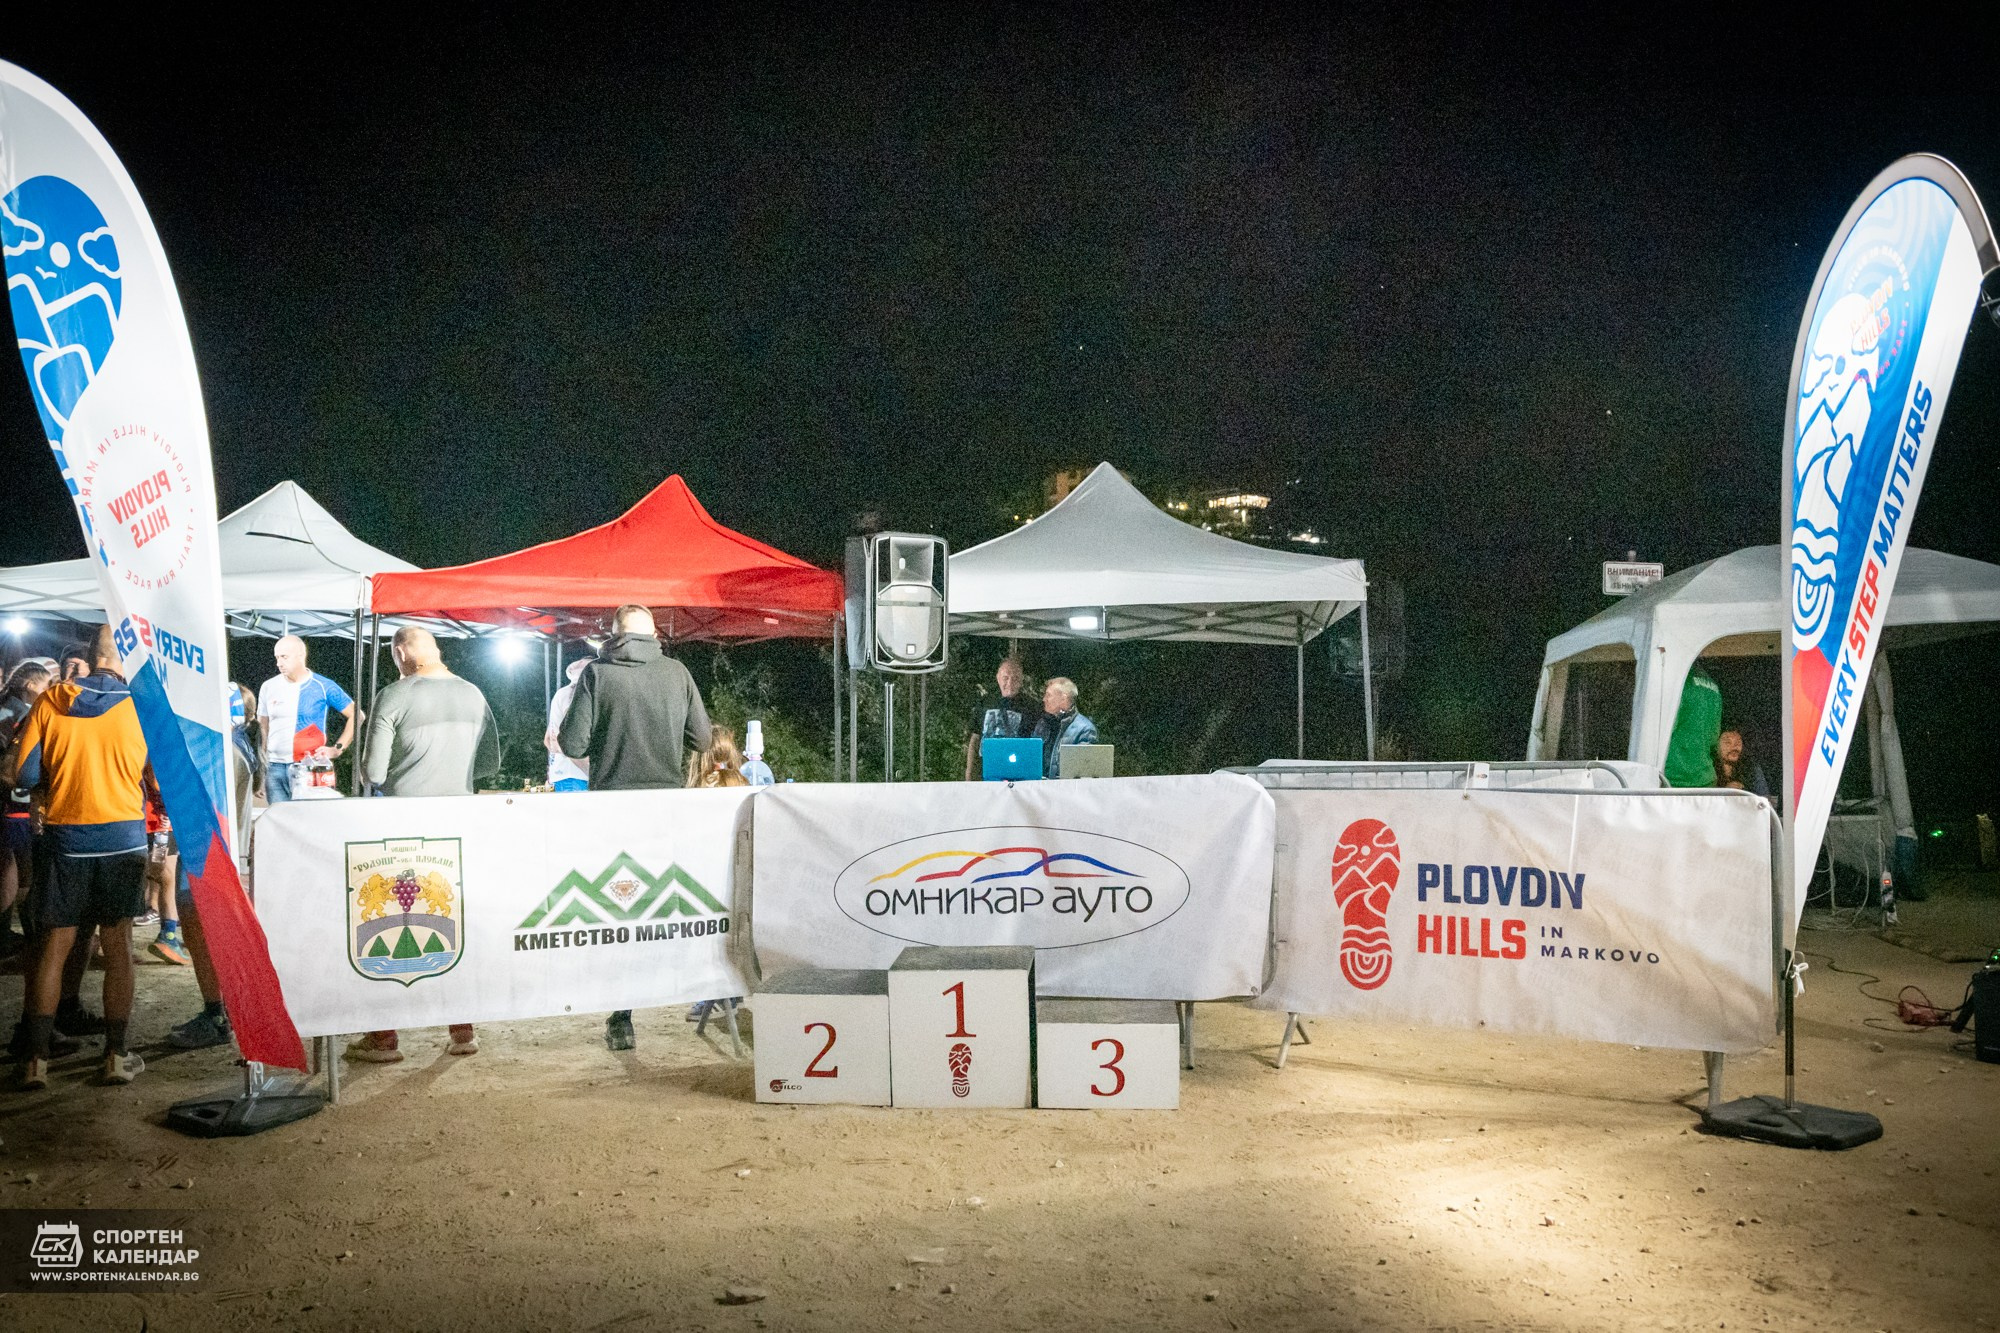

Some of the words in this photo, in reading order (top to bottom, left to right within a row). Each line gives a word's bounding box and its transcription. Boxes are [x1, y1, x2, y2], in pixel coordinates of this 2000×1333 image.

[1821, 650, 1860, 767] EVERY
[1849, 558, 1879, 660] STEP
[1872, 379, 1933, 568] MATTERS
[1418, 863, 1586, 909] PLOVDIV
[514, 926, 630, 951] КМЕТСТВО
[635, 917, 730, 942] МАРКОВО
[1418, 914, 1527, 960] HILLS
[1541, 925, 1563, 939] IN
[1541, 945, 1660, 964] MARKOVO
[942, 981, 977, 1038] 1
[804, 1022, 838, 1078] 2
[1090, 1038, 1126, 1097] 3
